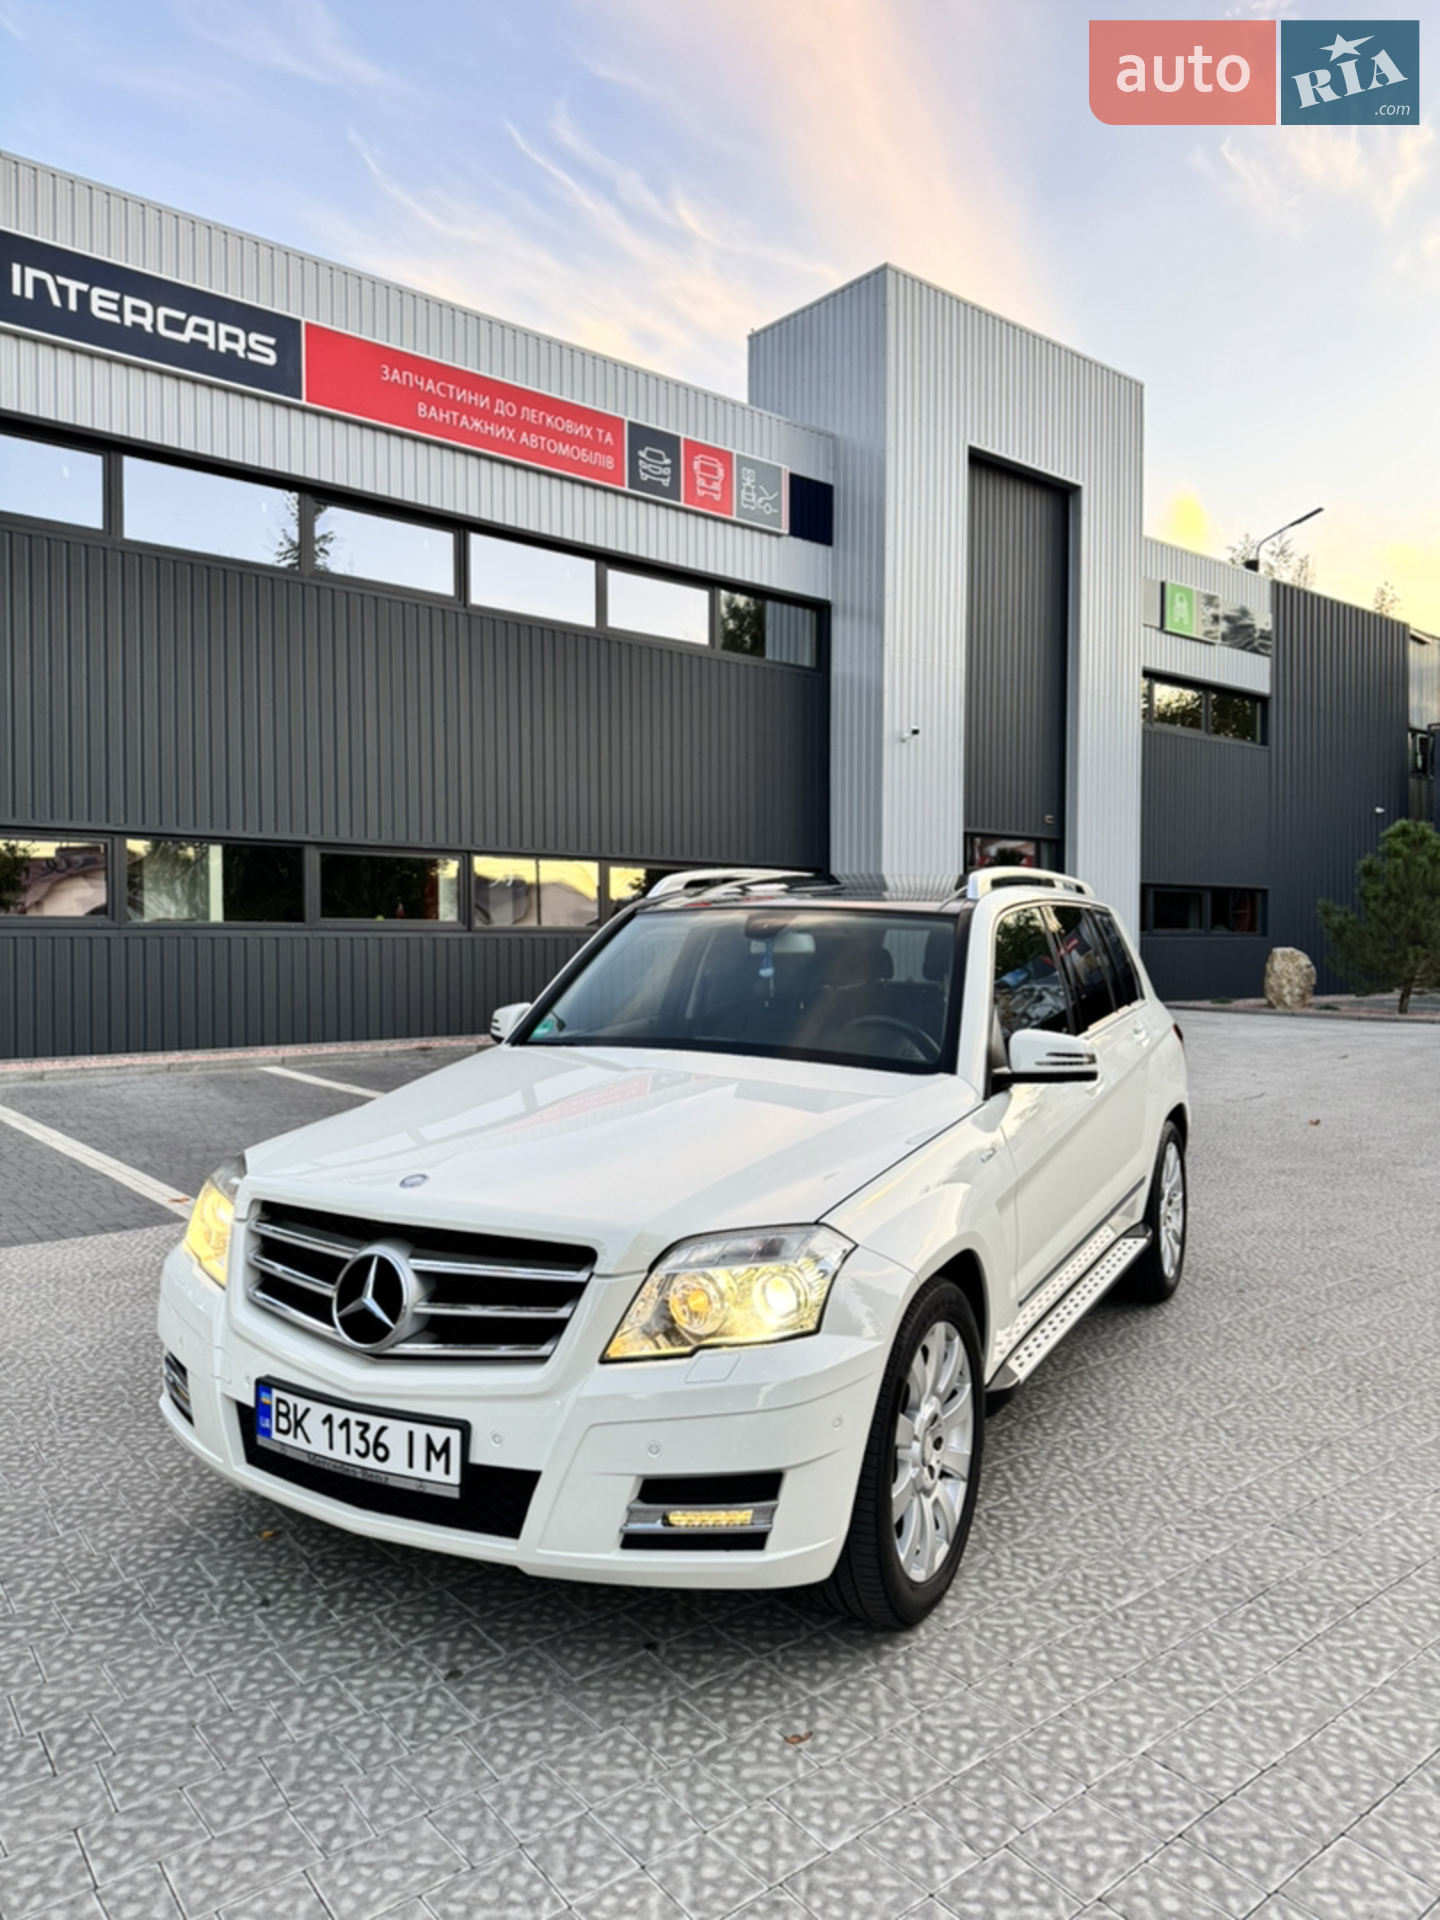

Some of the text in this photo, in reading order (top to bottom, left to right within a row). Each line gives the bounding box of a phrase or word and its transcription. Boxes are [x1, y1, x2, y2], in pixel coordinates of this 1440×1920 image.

[380, 364, 614, 446] ЗАПЧАСТИНИ ДО ЛЕГКОВИХ ТА
[416, 401, 615, 470] ВАНТАЖНИХ АВТОМОБІЛІВ
[275, 1396, 451, 1476] BK 1136 IM
